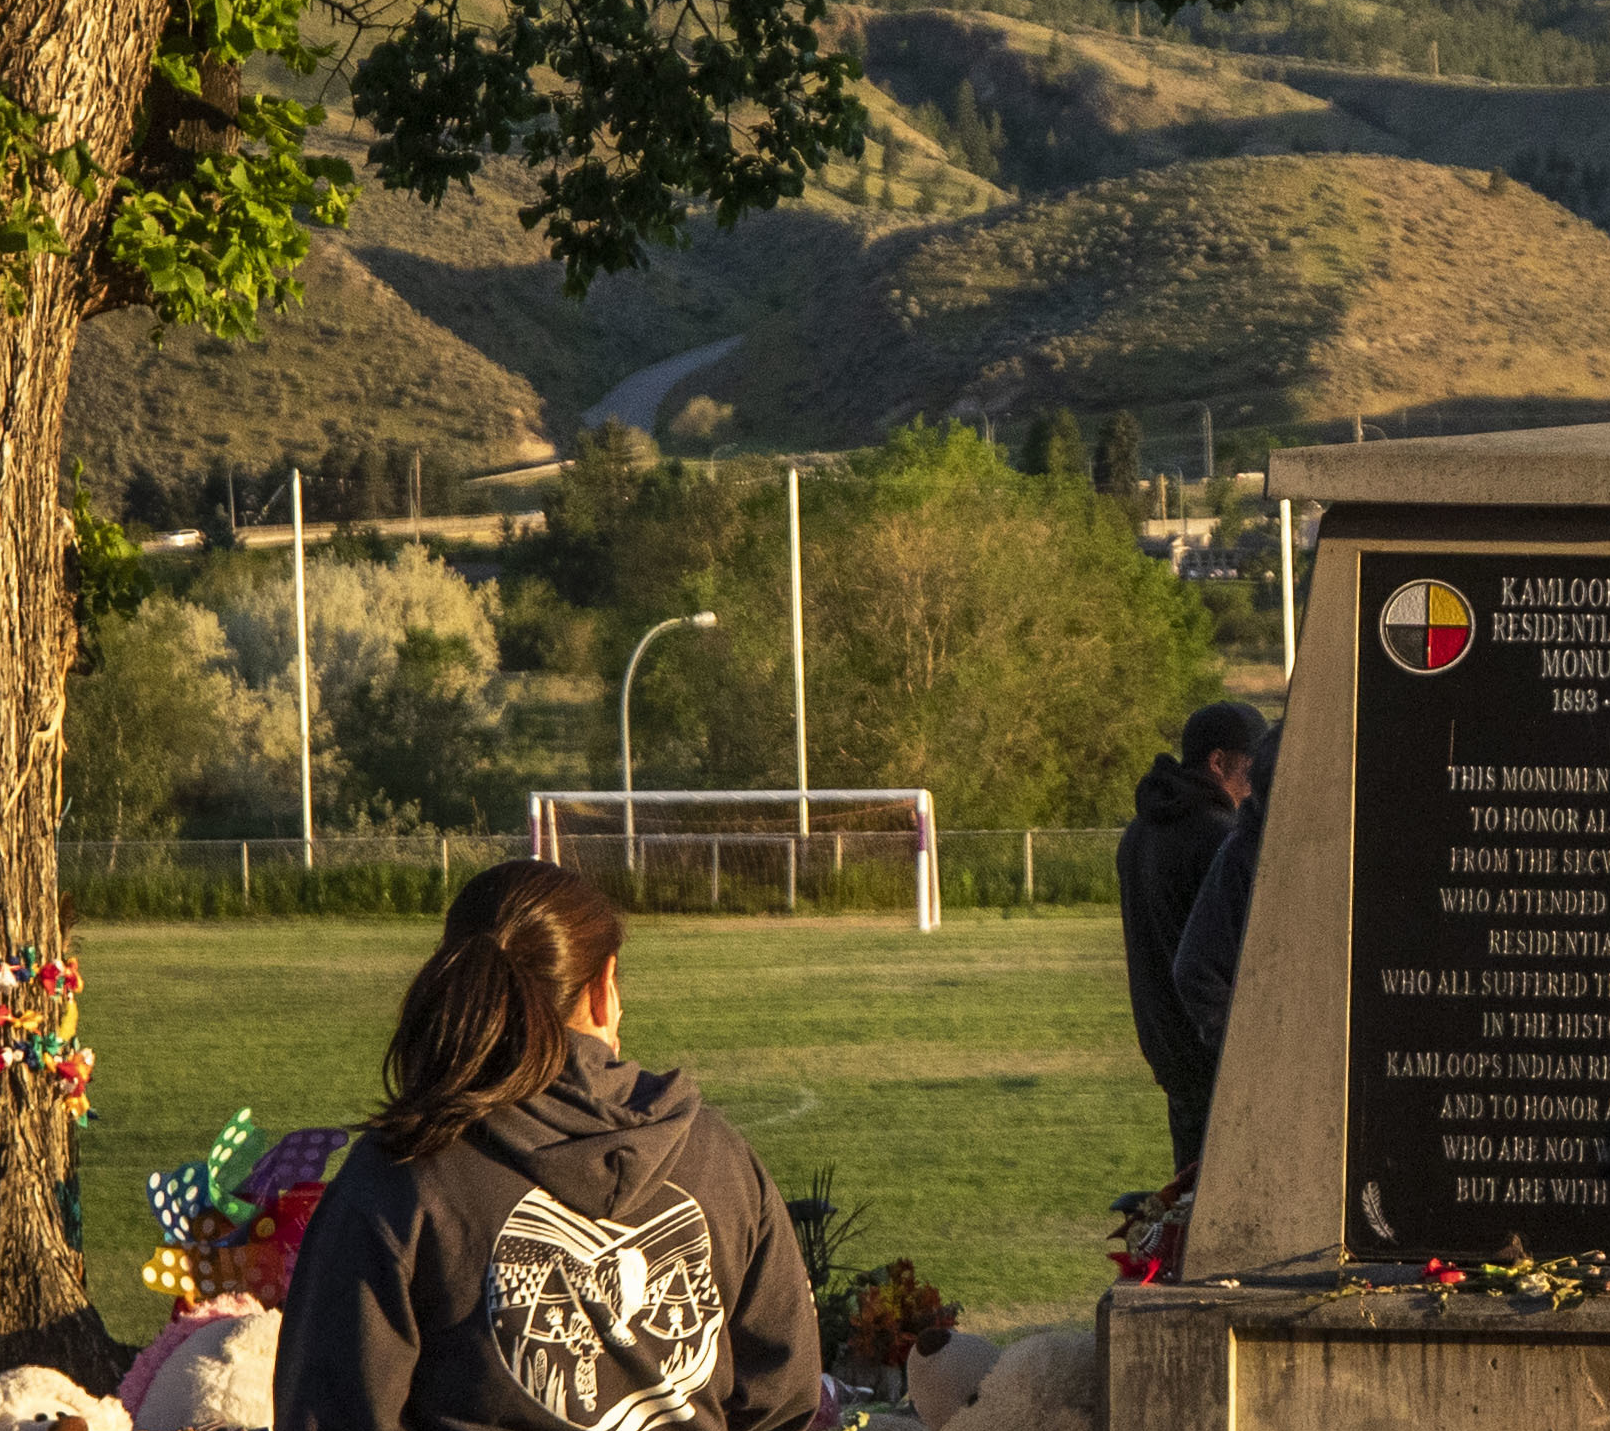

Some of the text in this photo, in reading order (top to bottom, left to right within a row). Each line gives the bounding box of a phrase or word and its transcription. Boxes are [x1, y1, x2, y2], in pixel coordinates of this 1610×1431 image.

[1553, 689, 1598, 712] 1893
[1447, 765, 1495, 790] THIS
[1470, 806, 1499, 831] TO
[1505, 807, 1578, 832] HONOR
[1450, 847, 1508, 872] FROM
[1515, 848, 1556, 874] THE
[1439, 888, 1490, 912] WHO
[1496, 889, 1606, 915] ATTENDED
[1381, 969, 1431, 995] WHO
[1437, 970, 1475, 996] ALL
[1481, 971, 1587, 997] SUFFERED
[1483, 1012, 1503, 1037] IN
[1510, 1012, 1551, 1038] THE
[1387, 1051, 1502, 1078] KAMLOOPS
[1508, 1054, 1582, 1079] INDIAN
[1440, 1094, 1483, 1119] AND
[1489, 1094, 1517, 1119] TO
[1524, 1095, 1598, 1121] HONOR
[1442, 1135, 1492, 1161] WHO
[1498, 1136, 1539, 1162] ARE
[1545, 1137, 1584, 1163] NOT
[1456, 1177, 1495, 1202] BUT
[1504, 1178, 1545, 1204] ARE
[1550, 1179, 1607, 1204] WITH
